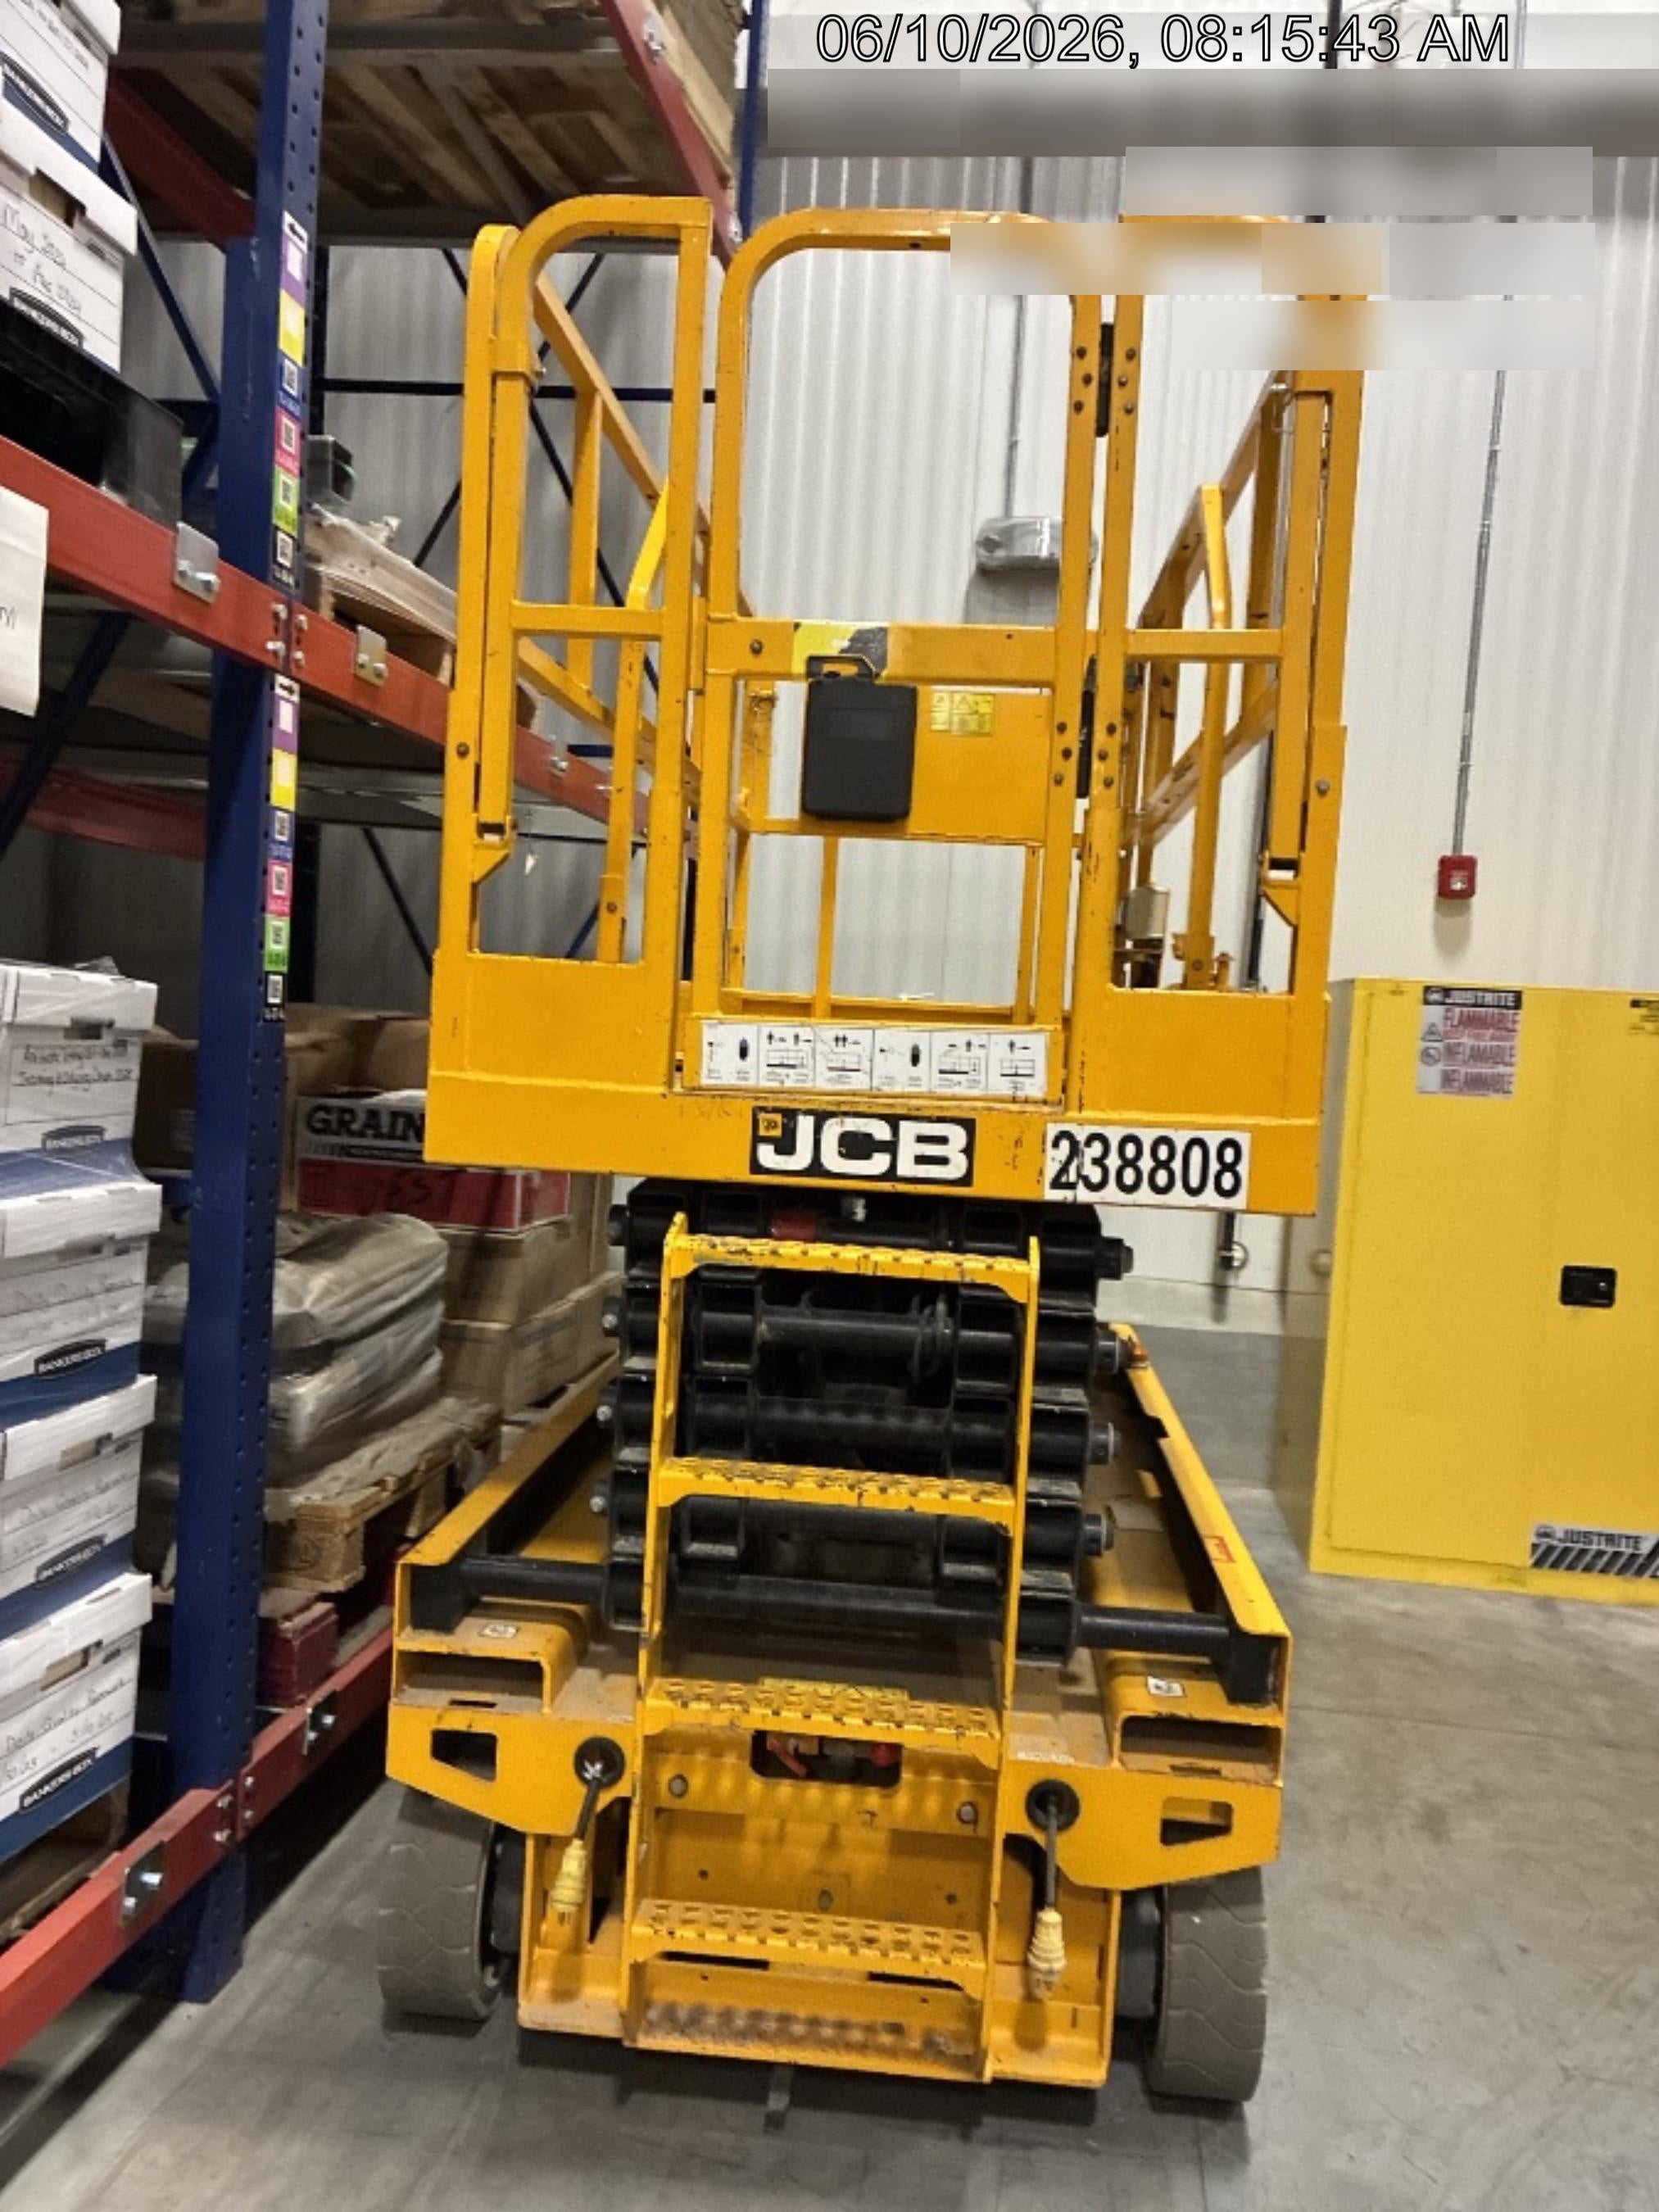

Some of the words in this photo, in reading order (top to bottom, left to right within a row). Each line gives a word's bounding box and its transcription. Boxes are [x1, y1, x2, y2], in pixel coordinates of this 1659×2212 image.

[306, 1103, 425, 1144] GRAIN
[756, 1113, 968, 1181] JCB
[1049, 1129, 1244, 1199] 238808
